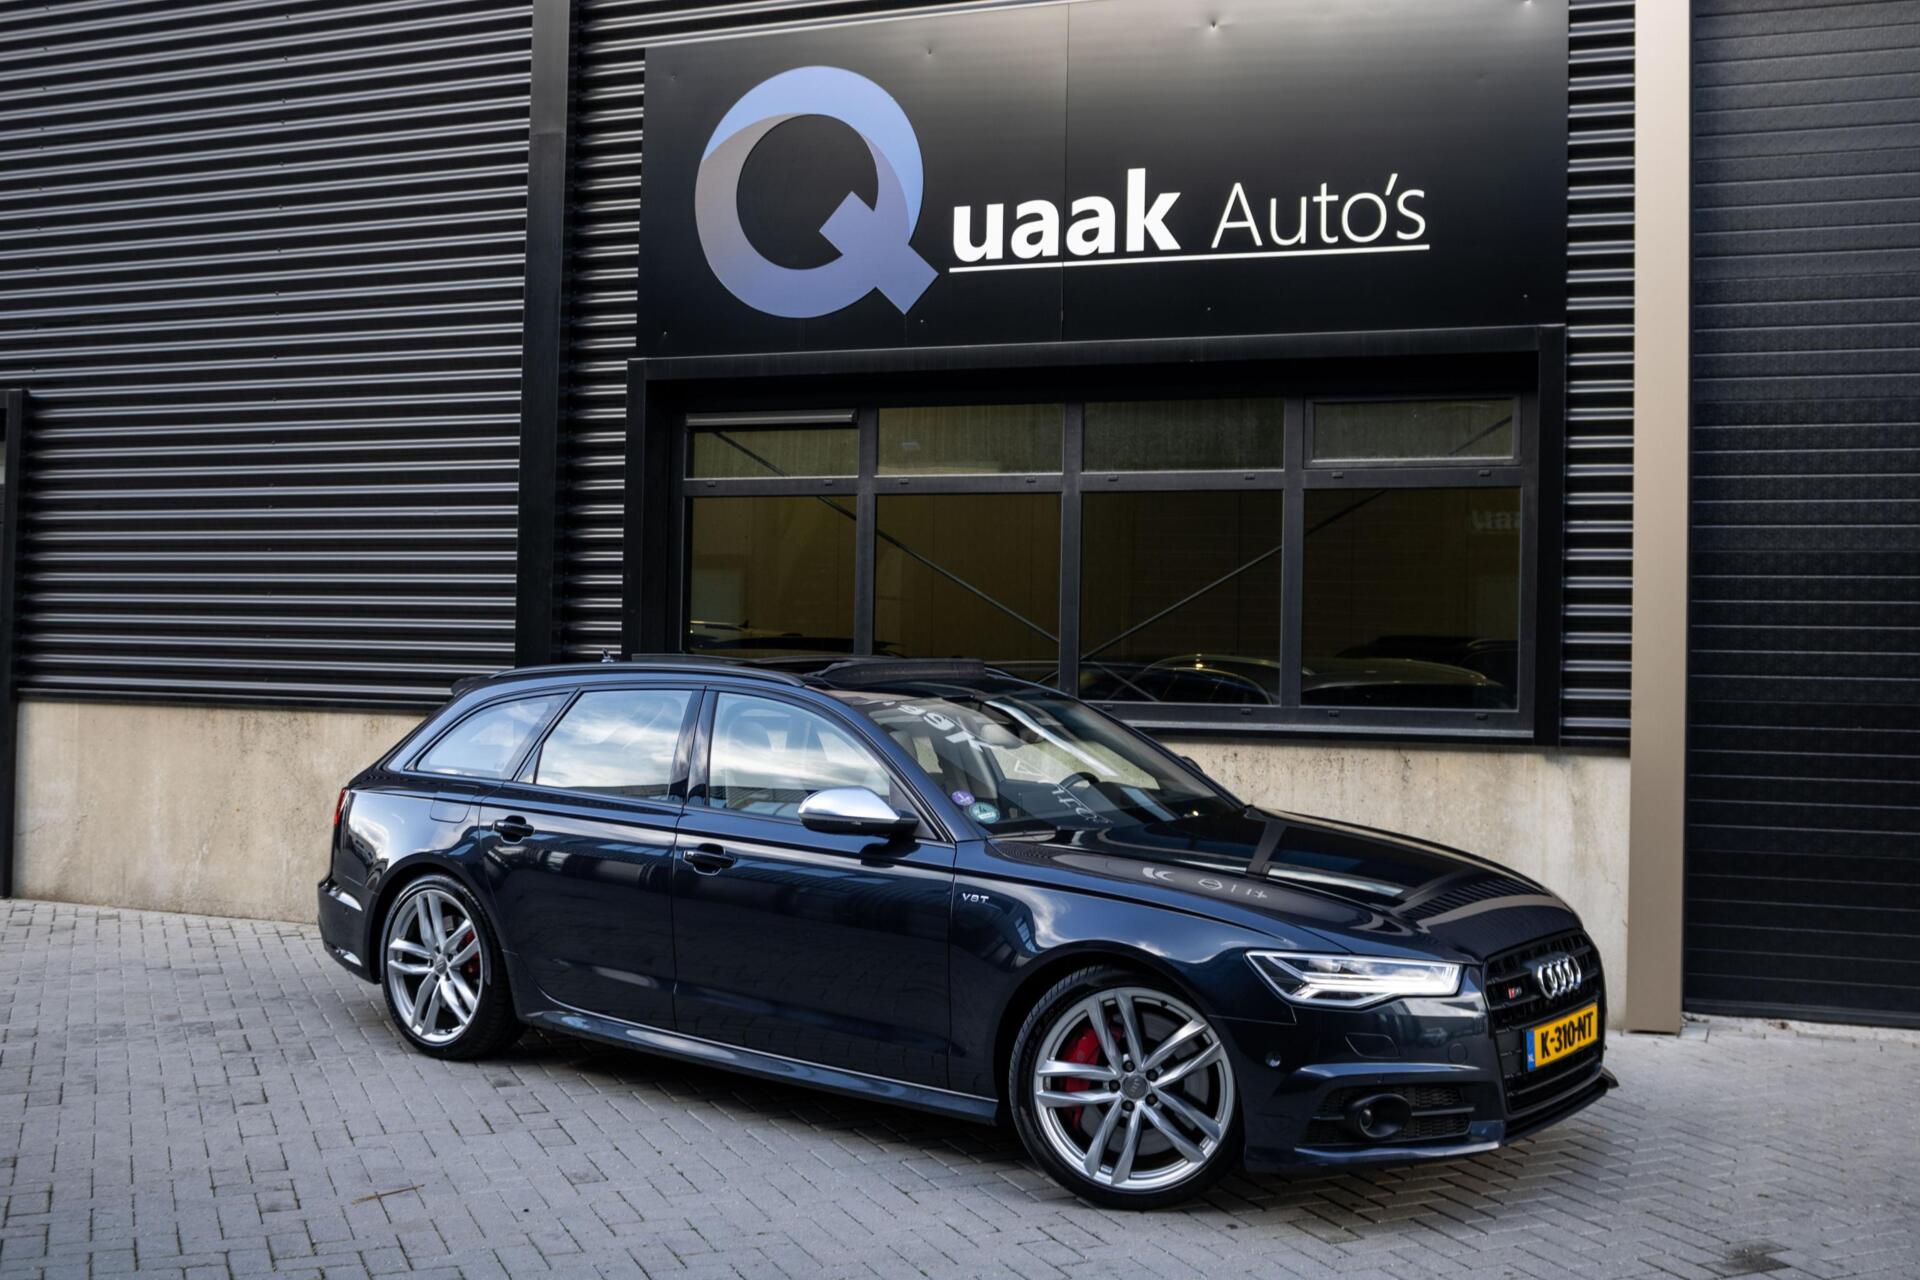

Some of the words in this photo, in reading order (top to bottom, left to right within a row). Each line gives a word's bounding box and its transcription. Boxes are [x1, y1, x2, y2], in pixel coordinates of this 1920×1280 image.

[1211, 173, 1426, 249] Auto's
[962, 892, 990, 904] V8T
[1541, 1011, 1594, 1060] K-310-NT
